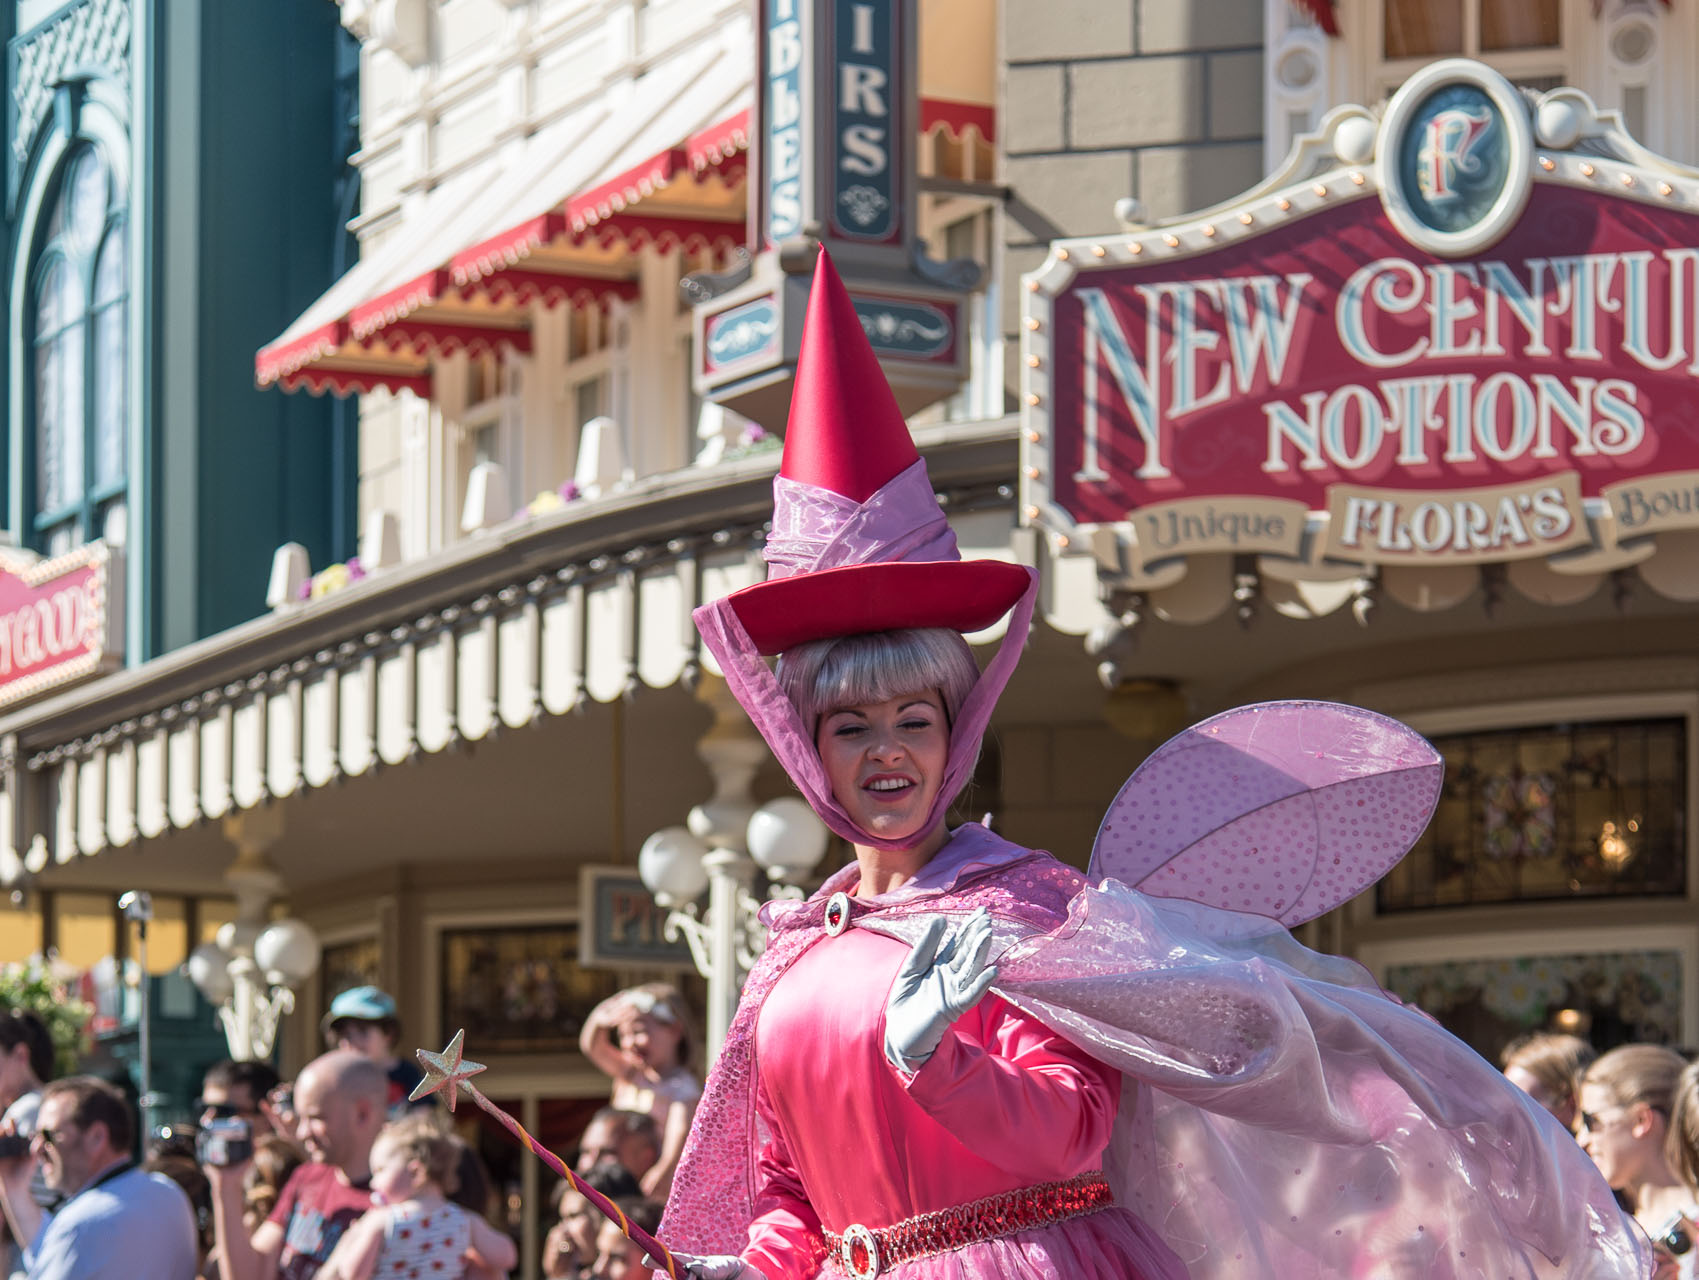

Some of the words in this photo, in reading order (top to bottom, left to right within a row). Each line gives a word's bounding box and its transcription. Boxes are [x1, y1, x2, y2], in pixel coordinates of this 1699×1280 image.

[1074, 273, 1312, 481] NEW
[1336, 247, 1699, 376] CENTU
[1263, 372, 1645, 473] NOTIONS
[1147, 505, 1286, 548] Unique
[1341, 488, 1572, 552] FLORA'S
